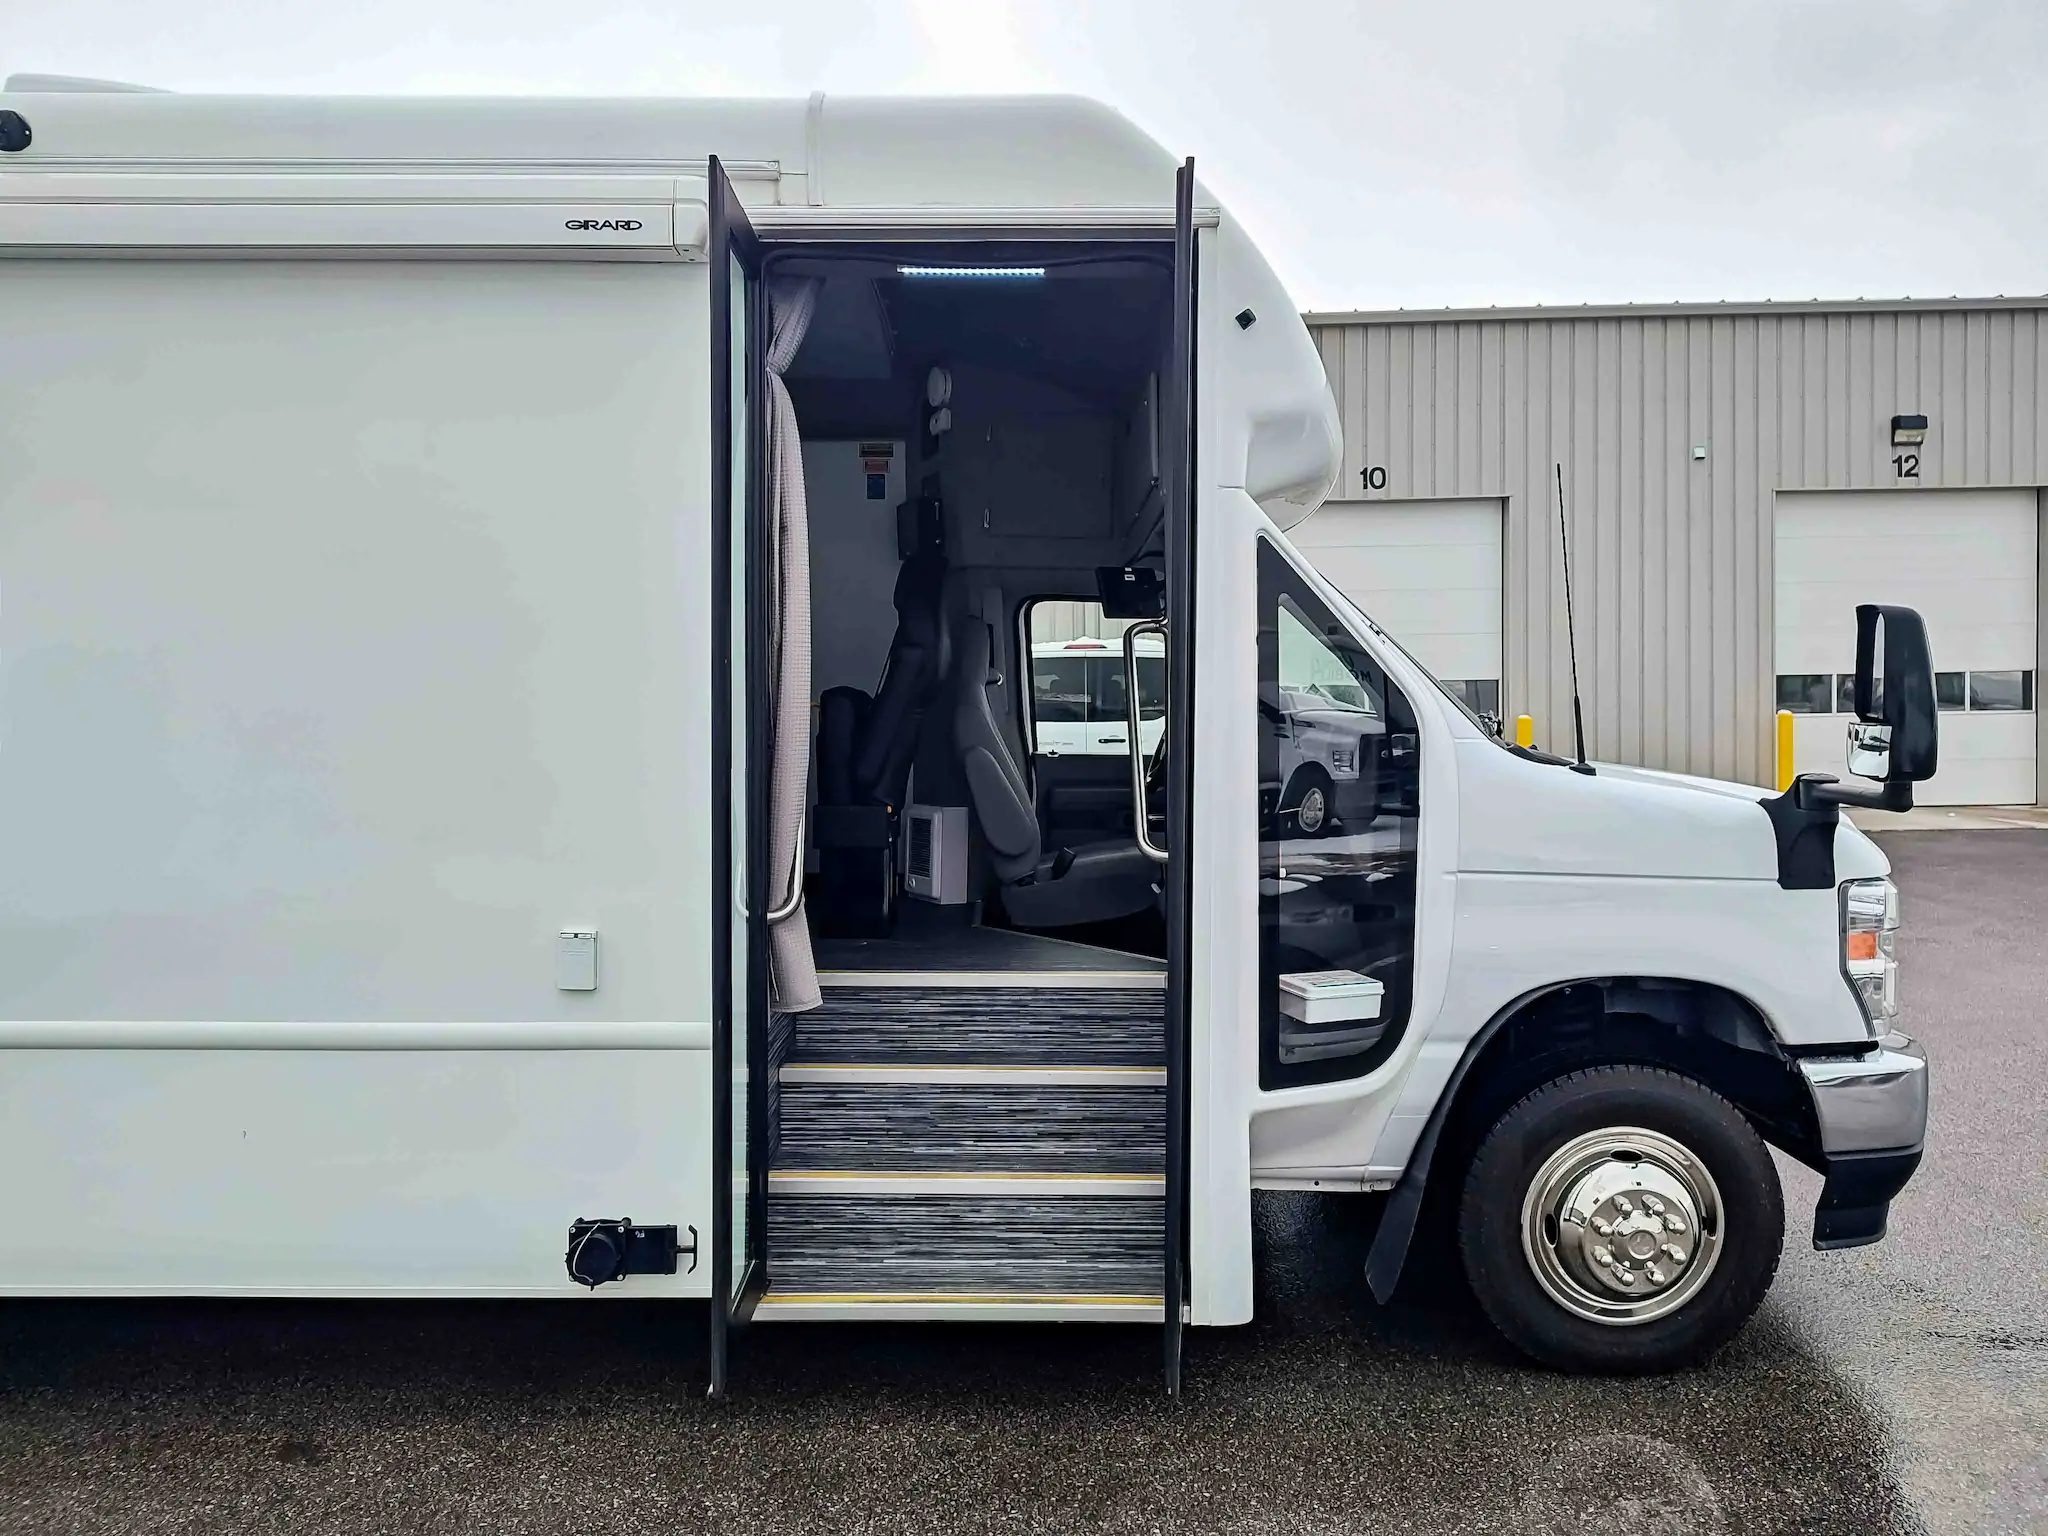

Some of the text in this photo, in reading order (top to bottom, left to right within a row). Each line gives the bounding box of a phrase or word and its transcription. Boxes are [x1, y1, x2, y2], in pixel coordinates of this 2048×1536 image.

[565, 220, 643, 231] GIRARD
[1360, 466, 1387, 490] 10
[1892, 454, 1919, 478] 12
